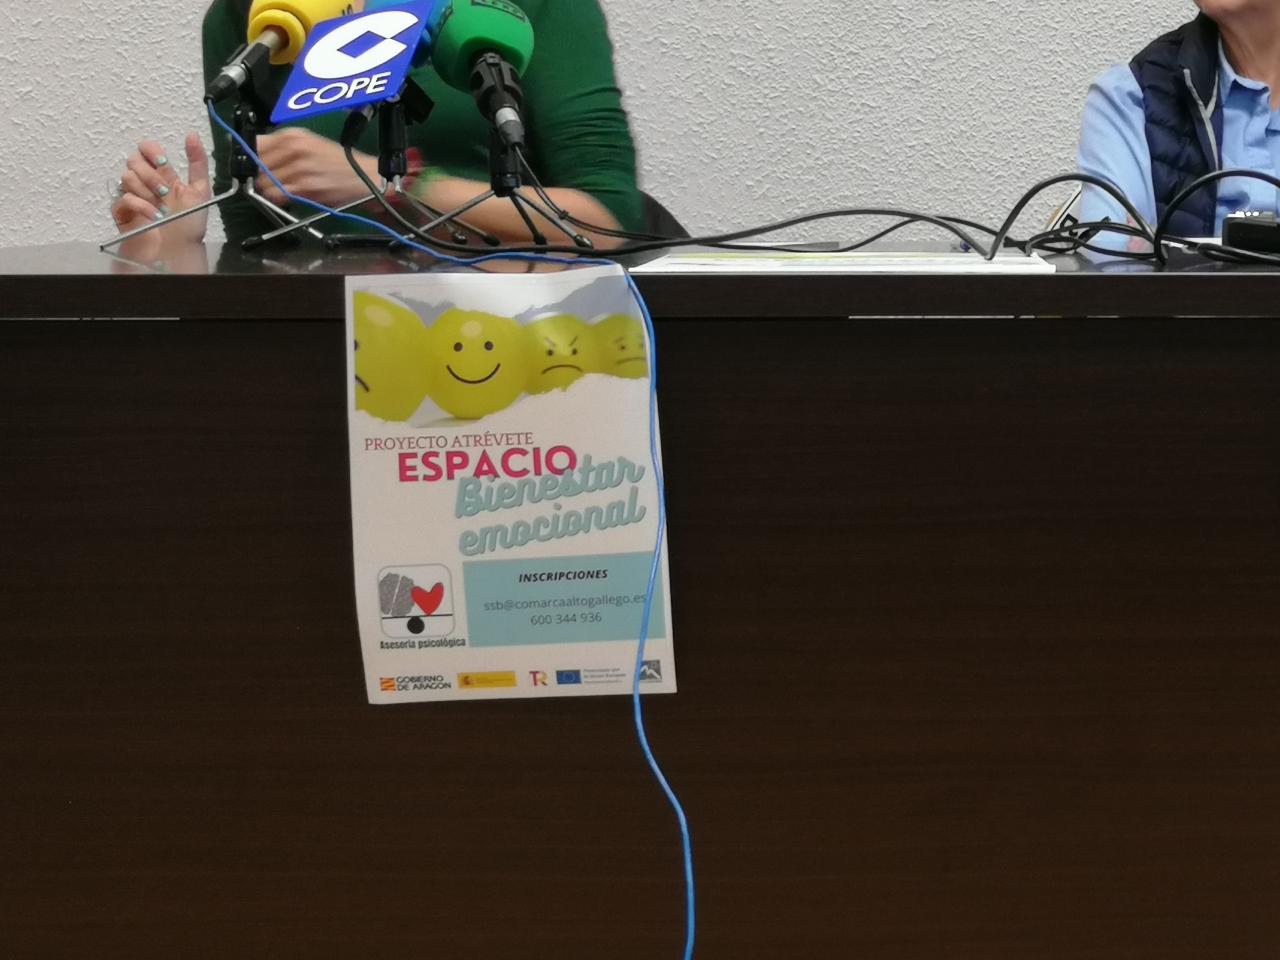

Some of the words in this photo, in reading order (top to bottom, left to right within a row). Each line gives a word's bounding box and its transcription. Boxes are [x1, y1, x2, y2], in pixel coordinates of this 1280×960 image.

[287, 71, 391, 110] COPE
[364, 435, 448, 451] PROYECTO
[451, 431, 534, 448] ATRÉVETE
[398, 445, 577, 482] ESPACIO
[455, 454, 645, 519] Bienestar
[458, 485, 647, 556] emocional
[519, 569, 608, 583] INSCRIPCIONES
[484, 593, 647, 611] ssb@comarcaaltogallego.es
[530, 614, 552, 626] 600
[556, 614, 577, 625] 344
[580, 613, 602, 624] 936
[396, 674, 444, 684] GOBIERNO
